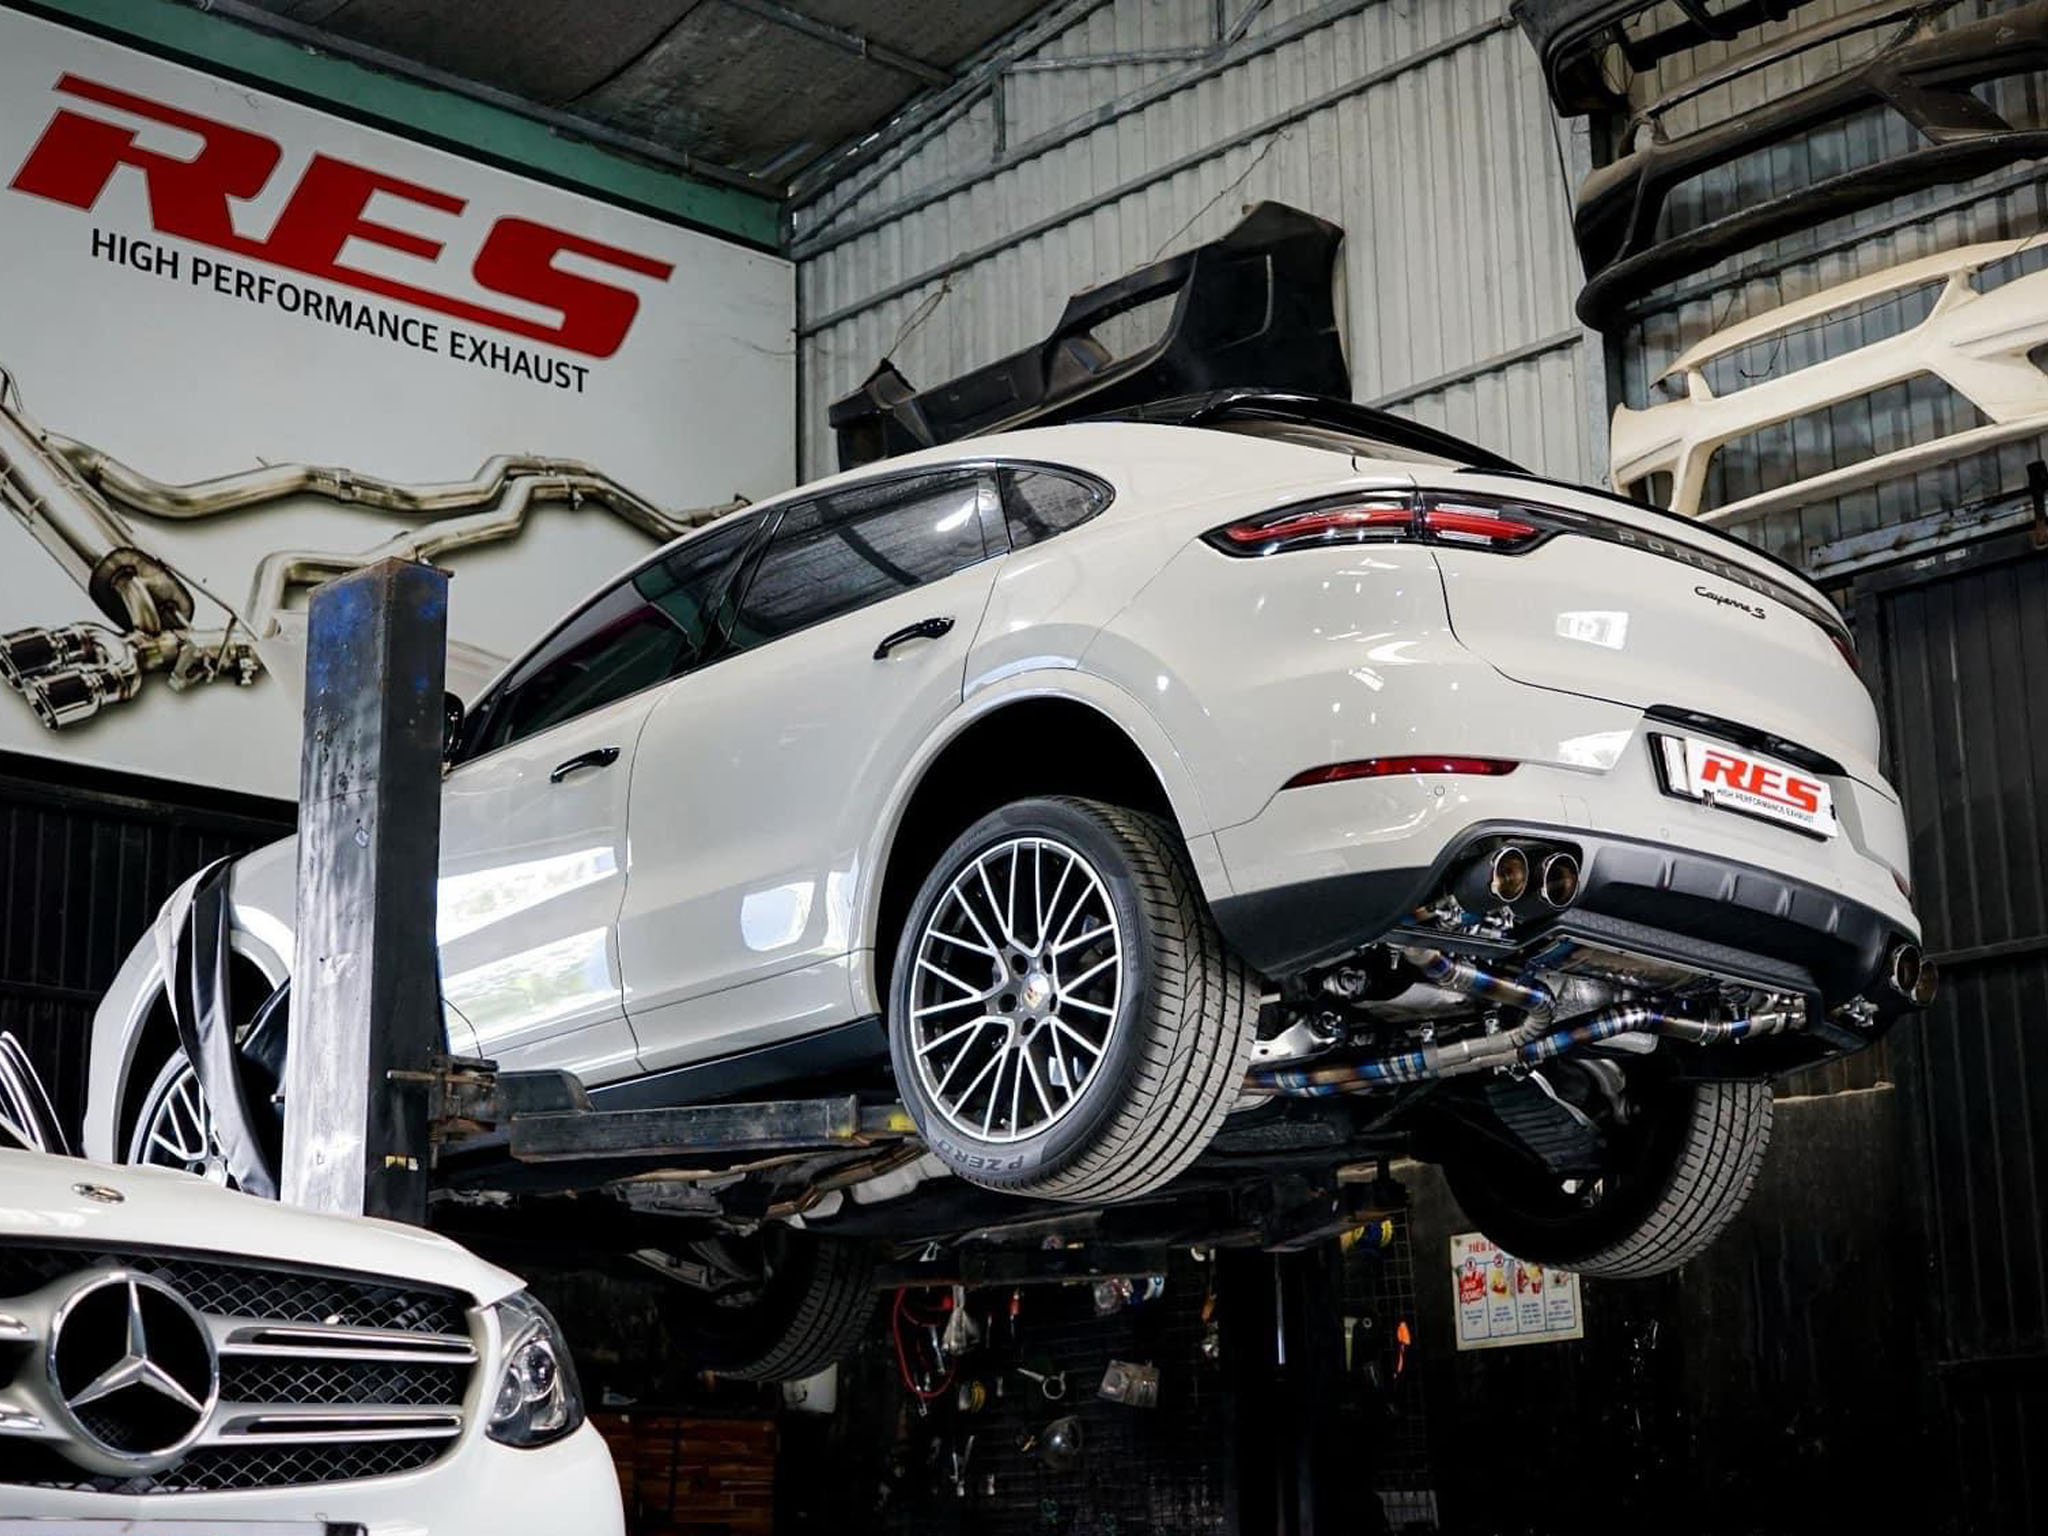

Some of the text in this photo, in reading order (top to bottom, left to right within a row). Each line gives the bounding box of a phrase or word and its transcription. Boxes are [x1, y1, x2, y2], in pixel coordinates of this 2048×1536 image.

[7, 71, 676, 360] RES
[92, 228, 590, 393] HIGH PERFORMANCE EXHAUST
[1694, 586, 1766, 620] Cayenne S
[1701, 750, 1821, 813] RES
[937, 1140, 1024, 1171] P ZERO
